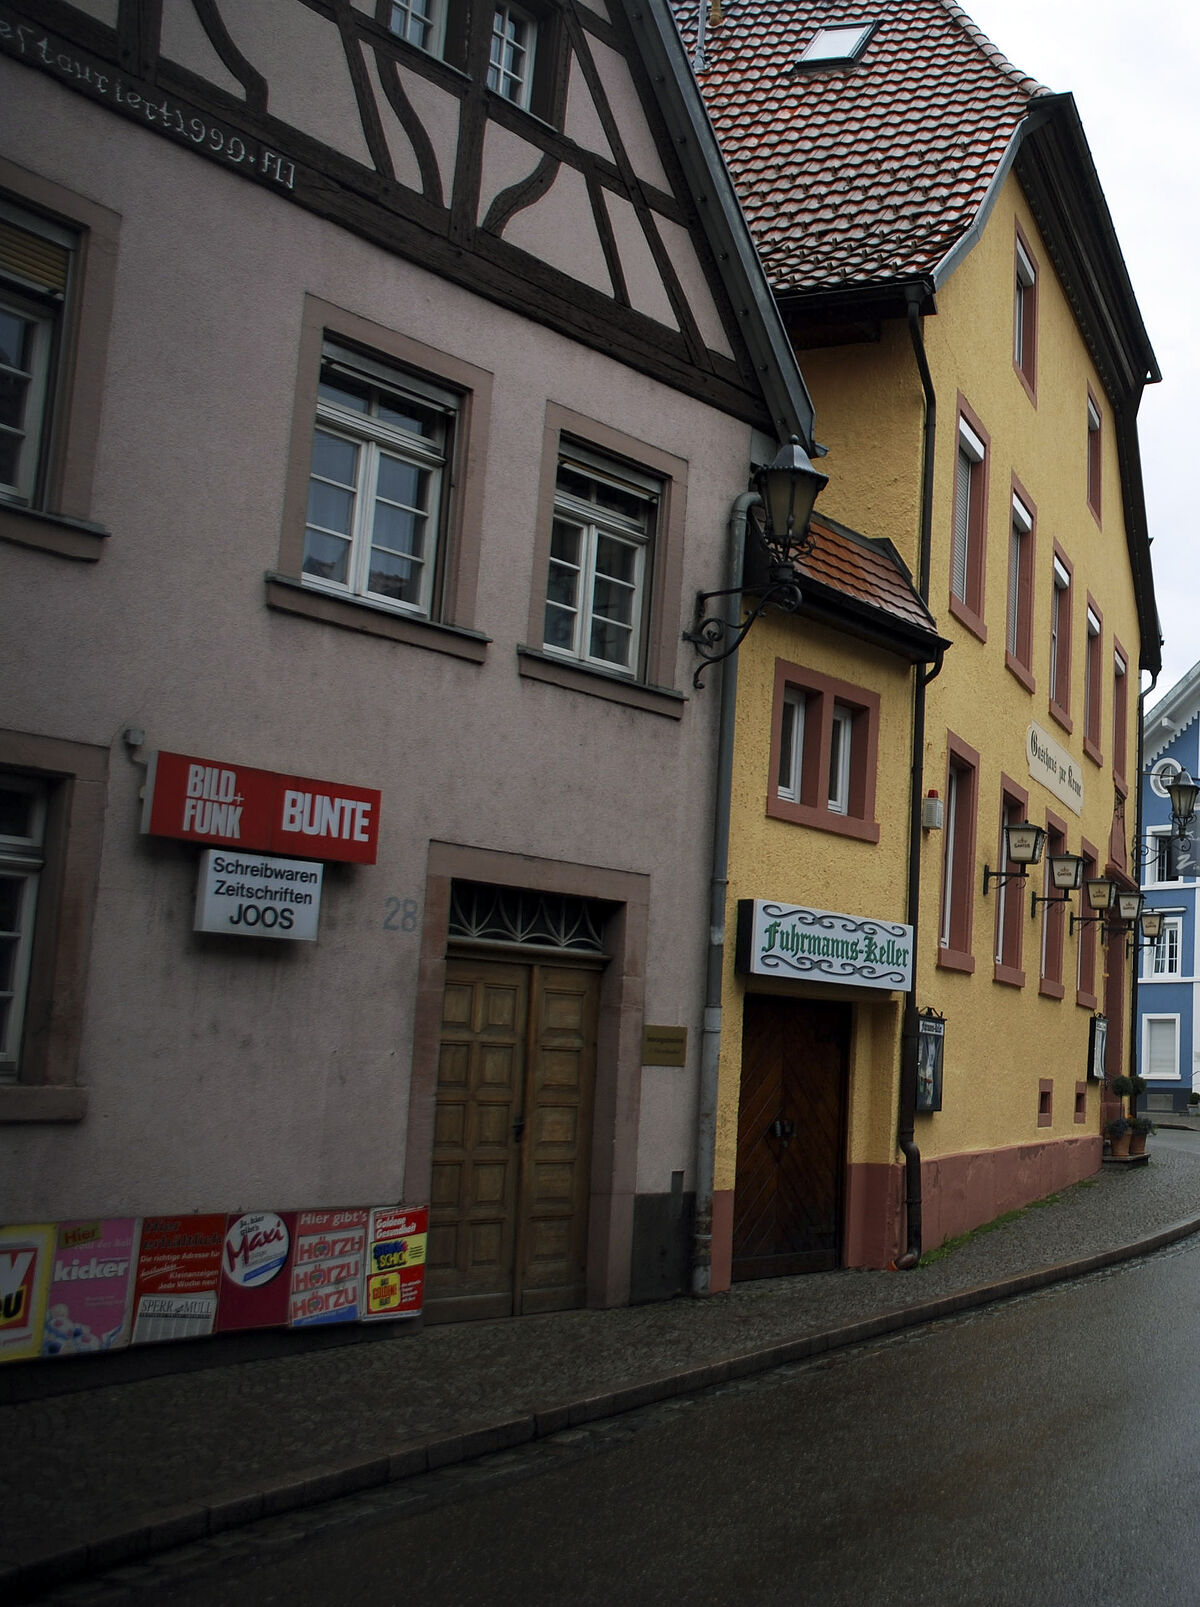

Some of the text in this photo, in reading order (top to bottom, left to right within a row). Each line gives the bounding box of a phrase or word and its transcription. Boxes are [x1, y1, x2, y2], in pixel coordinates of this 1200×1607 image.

[182, 798, 243, 839] FUNK
[282, 789, 371, 842] BUNTE
[213, 857, 318, 884] Schreibwaren
[215, 880, 313, 905] Zeitschriften
[229, 903, 295, 930] JOOS
[383, 897, 418, 933] 28
[761, 920, 910, 968] Fuhrmanns-Keller
[301, 1213, 329, 1225] Hier
[332, 1210, 368, 1226] gibt's
[64, 1227, 97, 1244] Hier
[226, 1221, 285, 1272] Maxi
[54, 1257, 129, 1282] kicker
[295, 1261, 360, 1291] HÖRZU
[293, 1286, 357, 1319] HÖRZU
